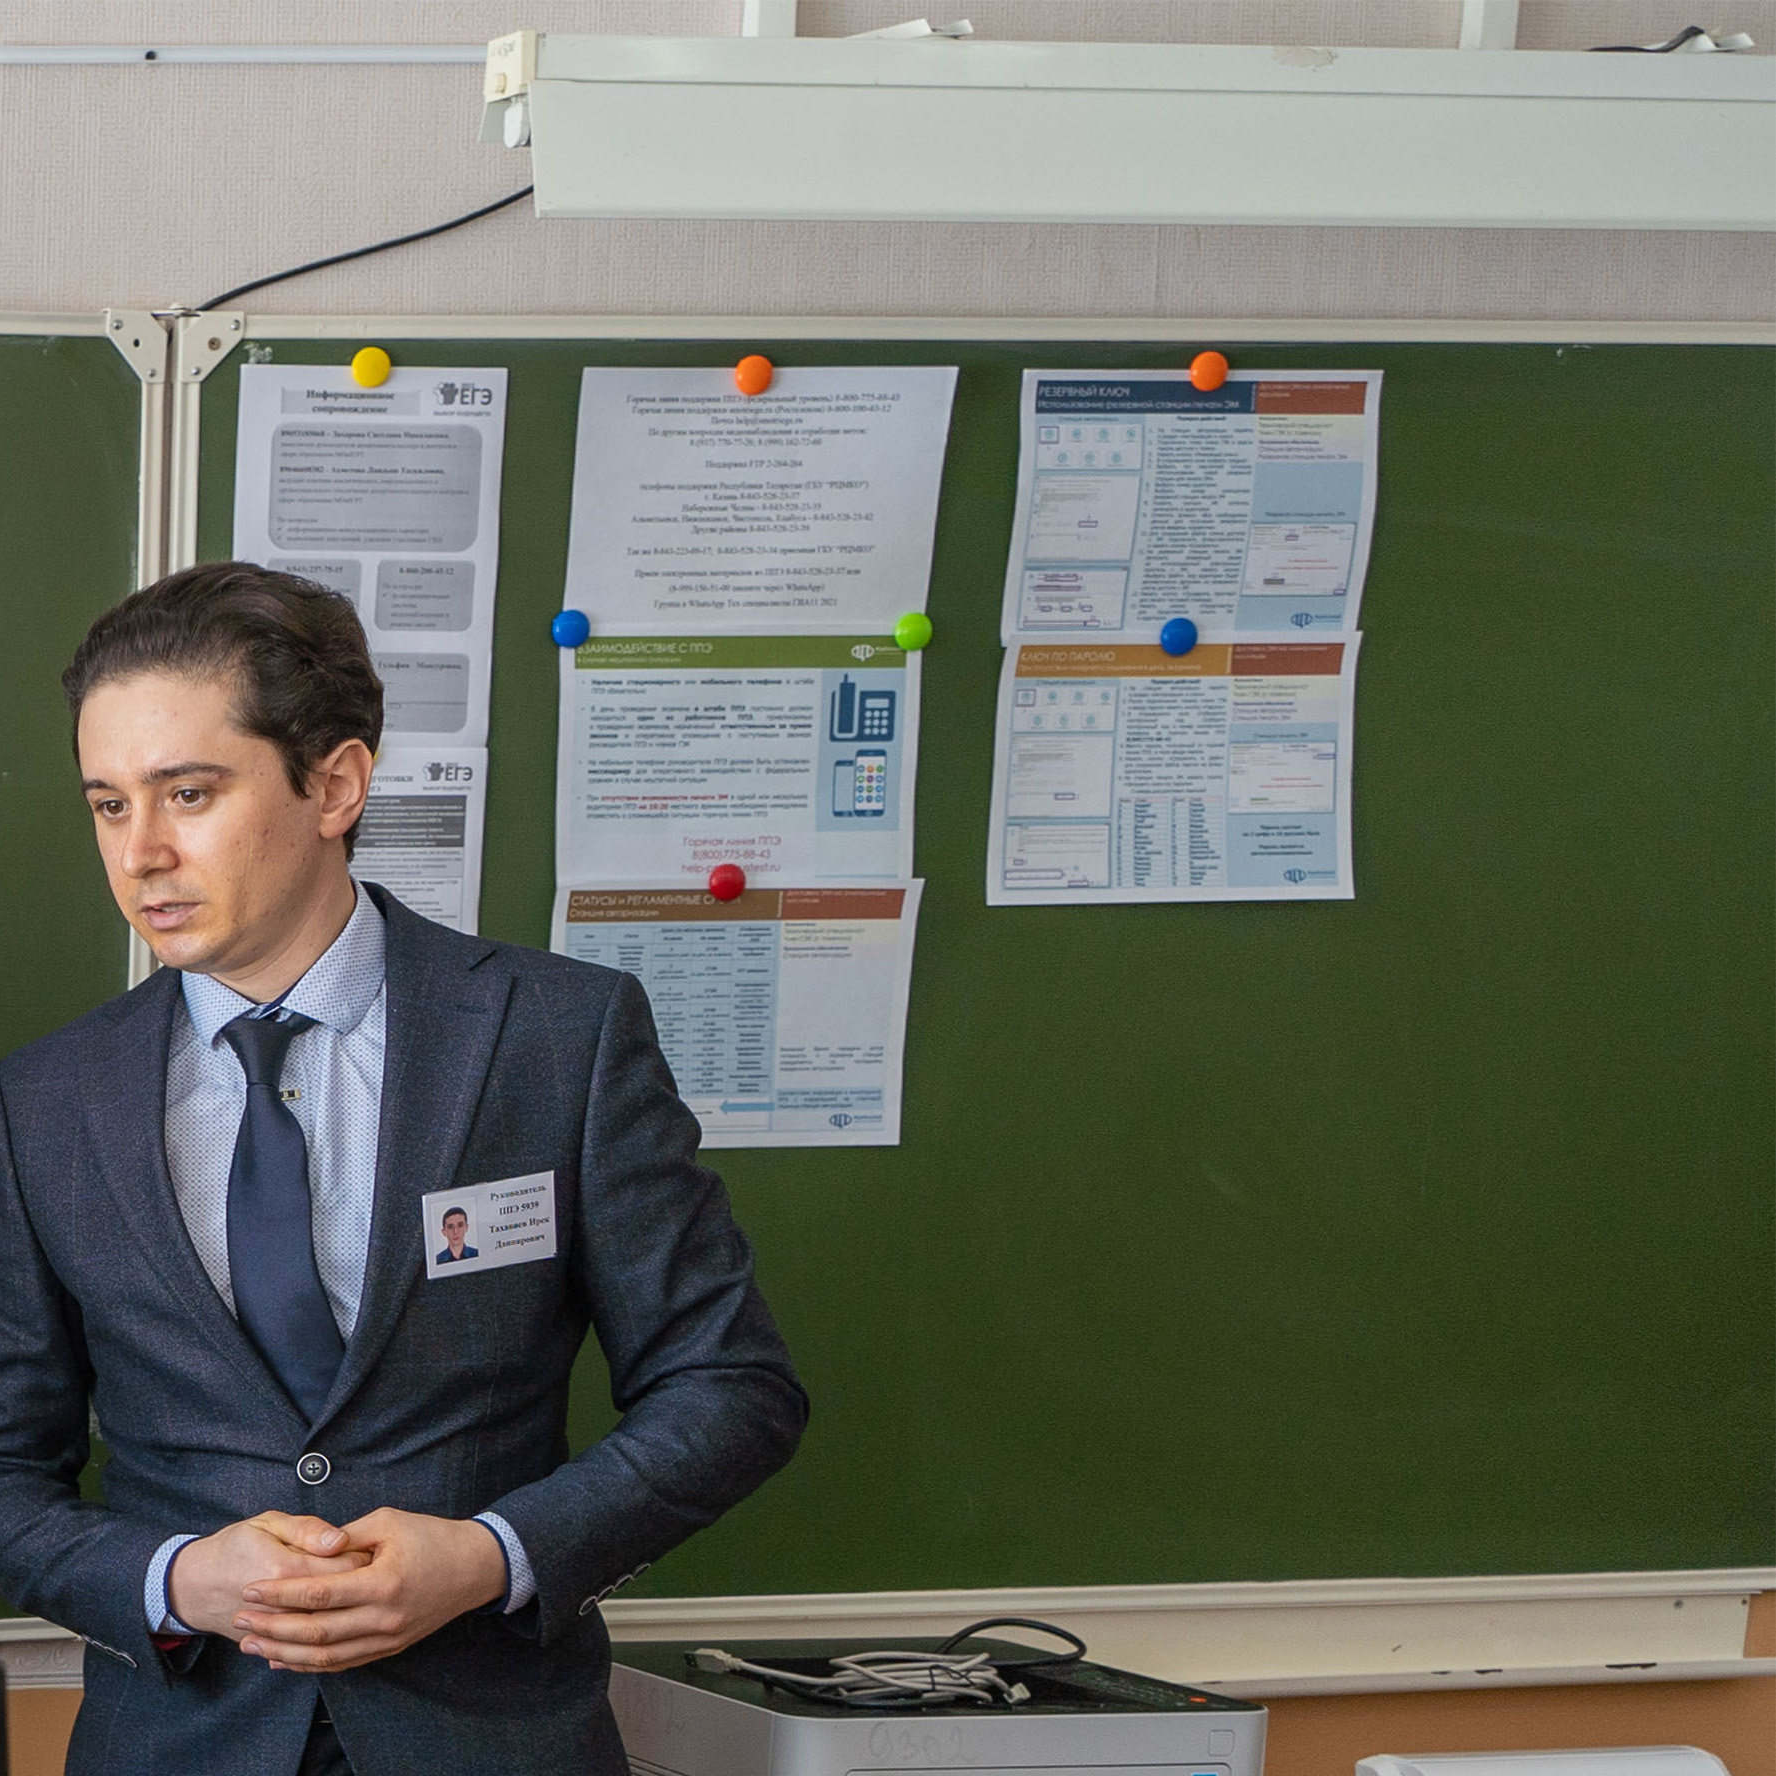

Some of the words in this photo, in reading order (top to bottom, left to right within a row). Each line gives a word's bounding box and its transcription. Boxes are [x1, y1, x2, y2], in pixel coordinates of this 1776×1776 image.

[307, 389, 394, 400] Информационное
[460, 387, 492, 405] ЕГЭ
[1039, 384, 1097, 397] РЕЗЕРВНЫЙ
[1099, 387, 1130, 396] КЛЮЧ
[312, 405, 388, 413] сопровождение
[1038, 400, 1104, 409] Использование
[689, 642, 713, 653] ППЭ
[445, 766, 473, 781] ЕГЭ
[683, 836, 723, 847] Горячая
[726, 837, 755, 846] линия
[758, 835, 782, 845] ППЭ
[571, 895, 617, 907] СТАТУСЫ
[569, 909, 604, 918] Станция
[490, 1185, 547, 1202] Руководитель
[499, 1206, 519, 1216] ППЭ
[529, 1216, 550, 1227] Ирек
